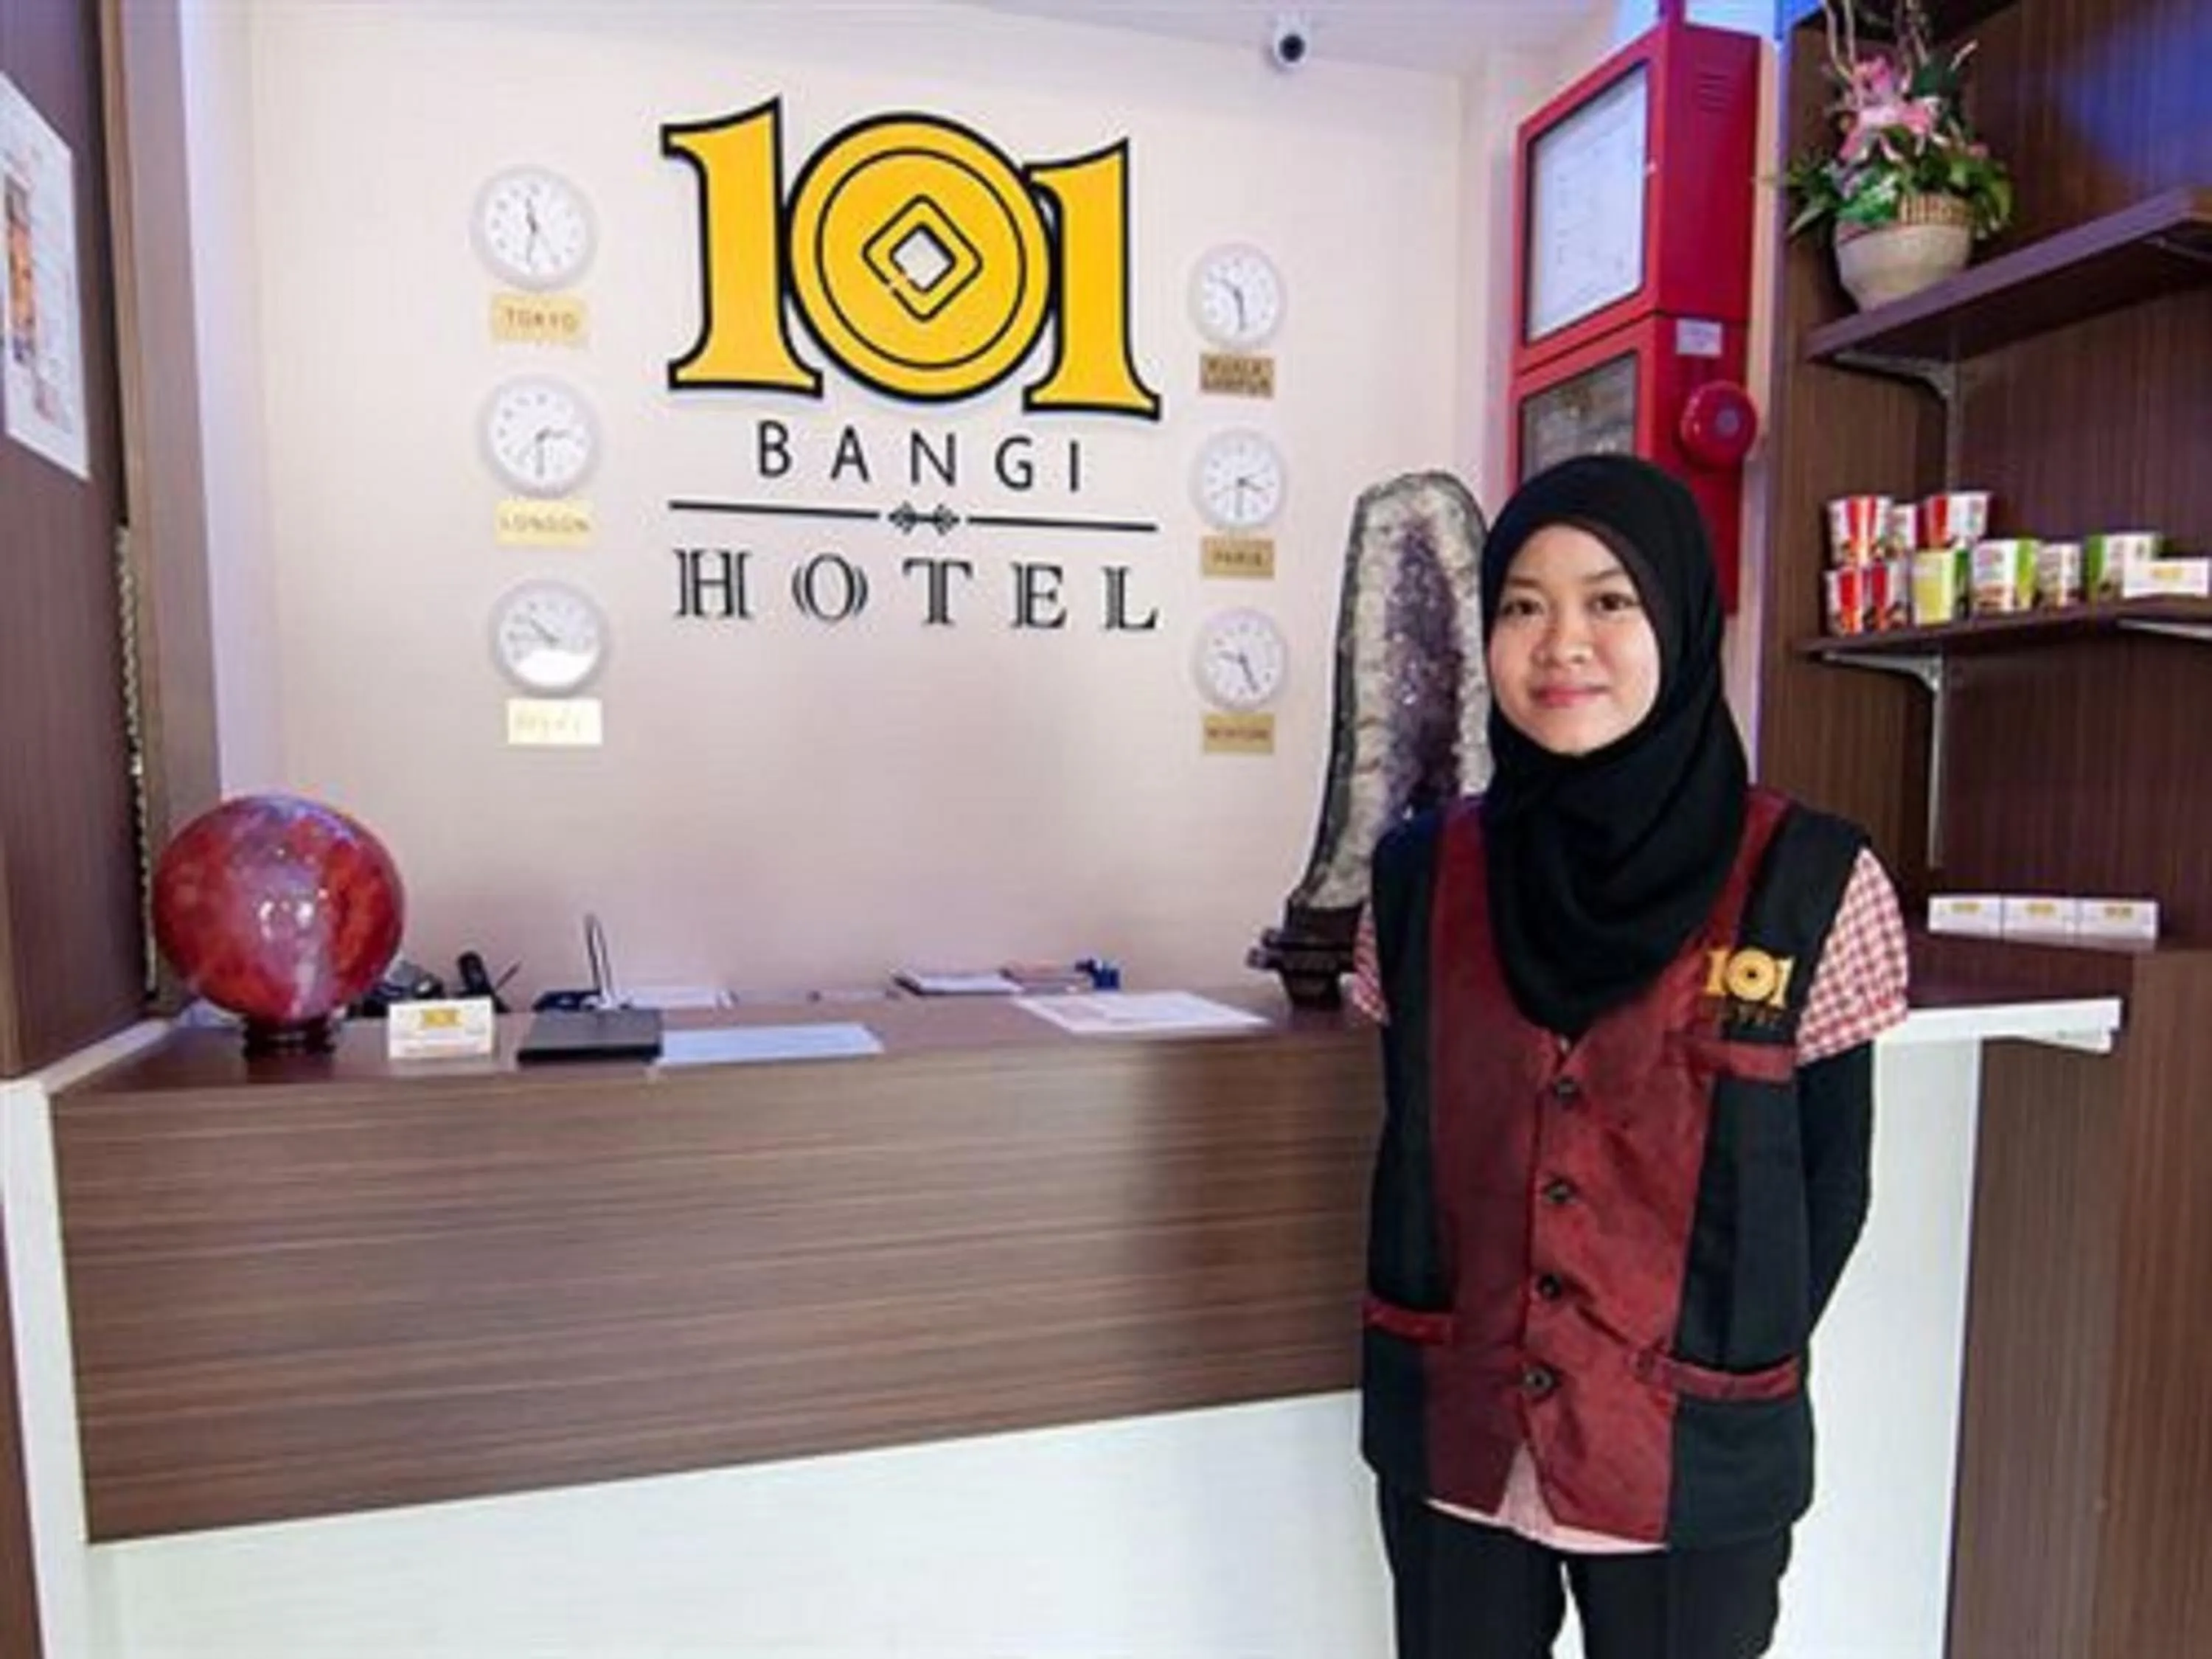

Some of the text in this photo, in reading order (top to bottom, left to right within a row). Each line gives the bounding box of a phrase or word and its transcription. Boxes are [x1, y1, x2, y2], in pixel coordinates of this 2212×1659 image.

[660, 95, 1162, 421] 101
[757, 420, 1082, 493] BANGI
[674, 549, 1160, 632] HOTEL
[1704, 947, 1795, 1008] 101
